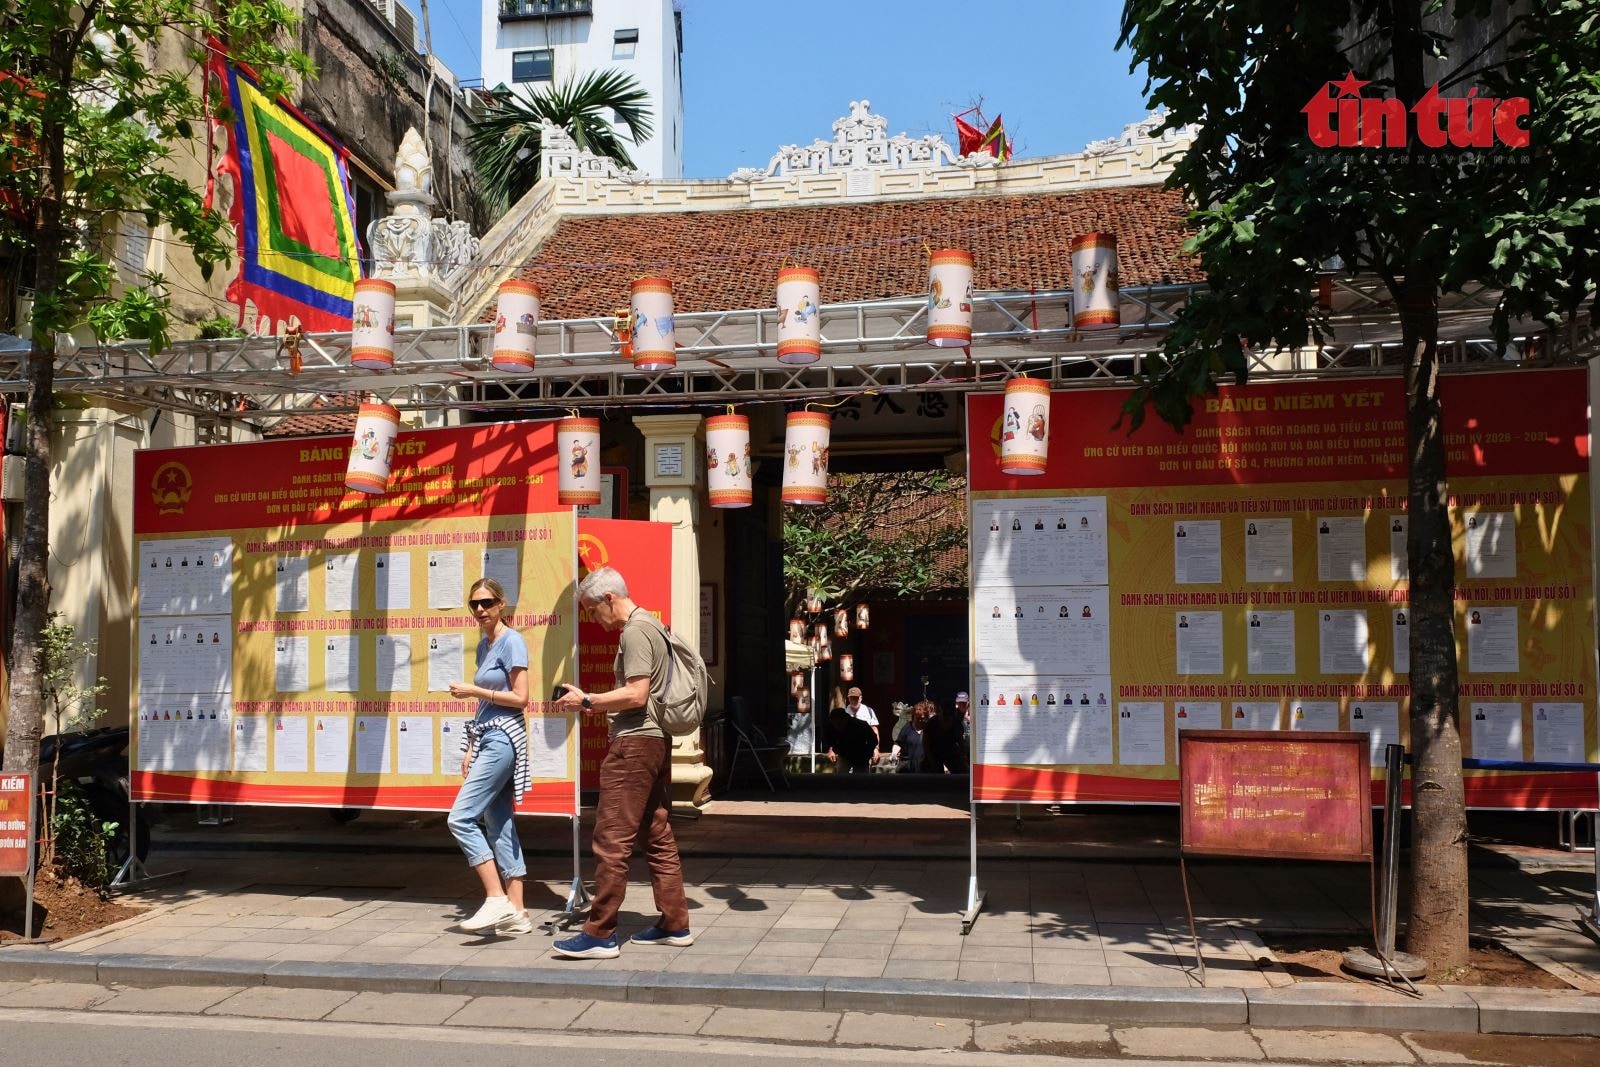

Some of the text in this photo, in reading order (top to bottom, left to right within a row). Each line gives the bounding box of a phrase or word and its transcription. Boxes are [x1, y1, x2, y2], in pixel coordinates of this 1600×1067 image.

[1205, 387, 1384, 413] BẢNG NIÊM YẾT
[1195, 427, 1222, 438] DANH
[1287, 424, 1321, 435] NGANG
[1486, 432, 1511, 443] 2026
[300, 446, 343, 463] BẢNG
[292, 474, 311, 485] DANH
[498, 476, 517, 486] 2026
[525, 475, 544, 485] 2031
[1130, 503, 1151, 516] DANH
[1200, 501, 1227, 514] NGANG
[1121, 593, 1141, 606] DANH
[1190, 592, 1216, 605] NGANG
[1573, 586, 1576, 599] 1
[1120, 685, 1140, 697] DANH
[1190, 685, 1216, 697] NGANG
[1578, 683, 1584, 696] 4
[1, 776, 25, 790] KIẾM
